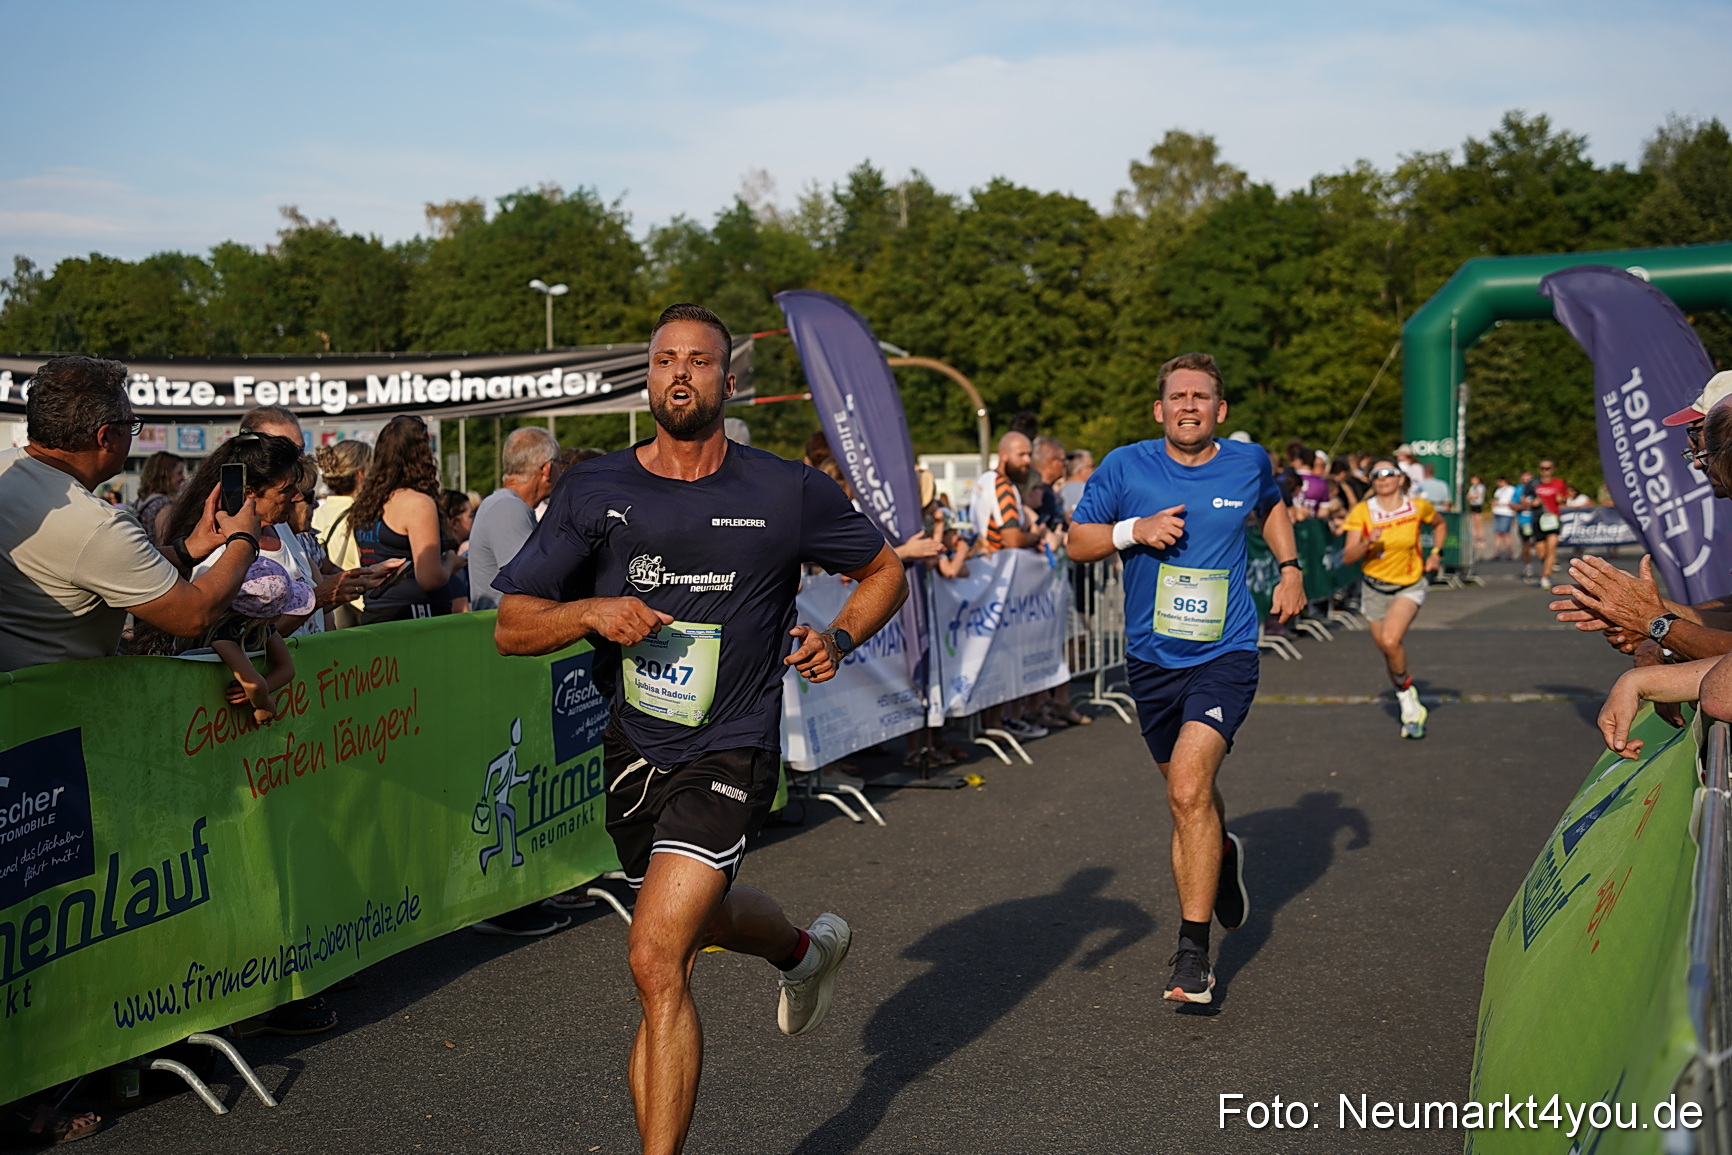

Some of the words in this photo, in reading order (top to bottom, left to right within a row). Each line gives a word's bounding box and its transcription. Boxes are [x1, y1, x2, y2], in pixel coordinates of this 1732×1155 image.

[125, 373, 226, 407] ätze.
[234, 372, 359, 414] Fertig.
[366, 367, 612, 404] Miteinander.
[720, 518, 766, 528] PFLEIDERER
[662, 571, 737, 585] Firmenlauf
[690, 582, 734, 593] neumarkt
[1173, 597, 1209, 614] 963
[634, 655, 695, 686] 2047
[634, 677, 660, 695] Ljubisa
[661, 687, 697, 702] Radovic
[183, 680, 311, 757] Gesude
[316, 655, 400, 709] Firmen
[242, 731, 327, 799] laufen
[333, 687, 421, 764] länger!
[528, 755, 606, 828] firme
[710, 780, 748, 804] VANQUISH
[531, 802, 595, 854] neumarkt
[20, 848, 36, 865] das
[23, 860, 49, 888] fährt
[51, 844, 81, 867] mit!
[113, 885, 422, 1029] www.firmenlauf-oberpfalz.de
